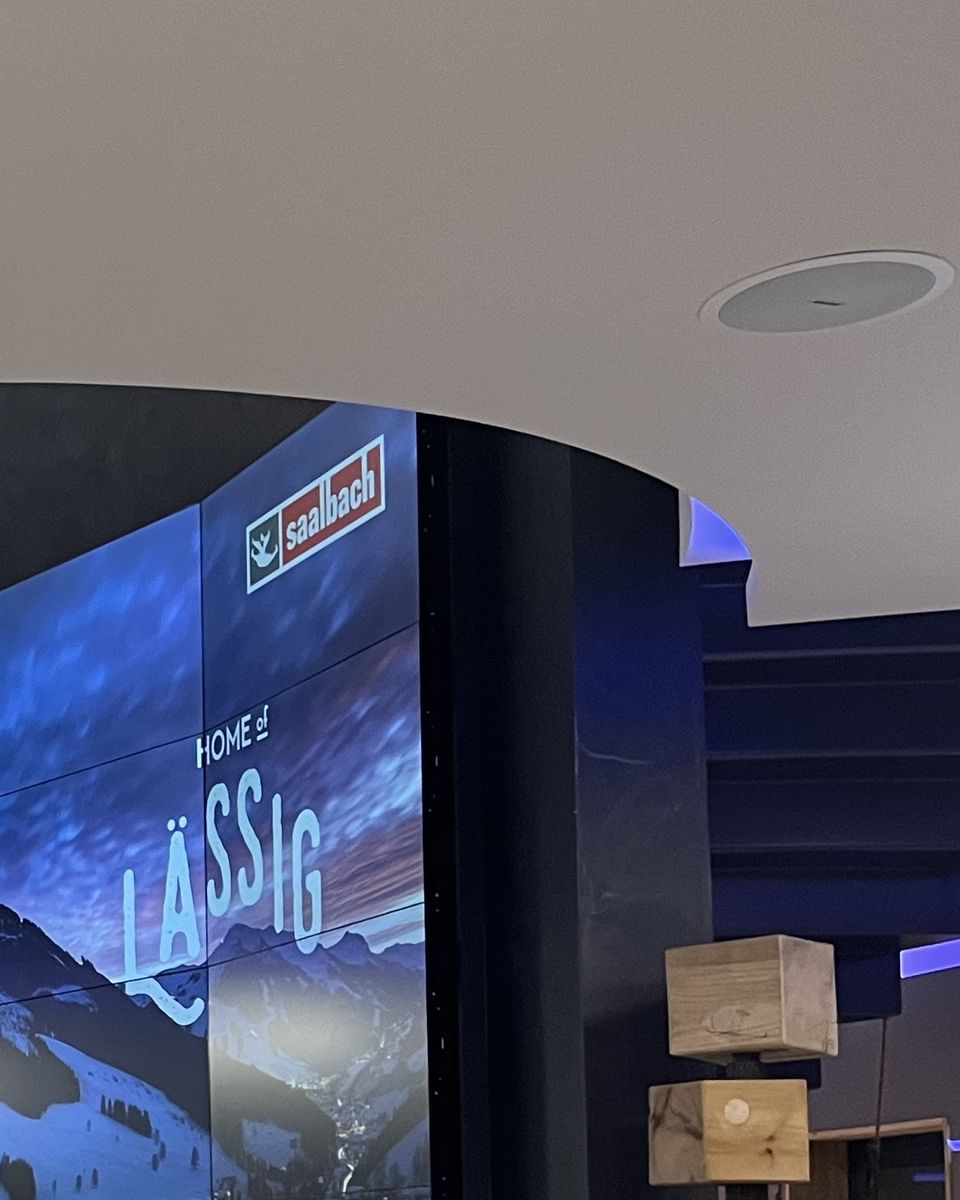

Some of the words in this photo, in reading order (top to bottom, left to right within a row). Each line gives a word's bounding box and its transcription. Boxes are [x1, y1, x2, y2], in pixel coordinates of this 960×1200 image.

[286, 449, 375, 550] saalbach
[196, 713, 252, 768] HOME
[256, 704, 269, 741] of
[123, 768, 322, 1025] LÄSSIG
